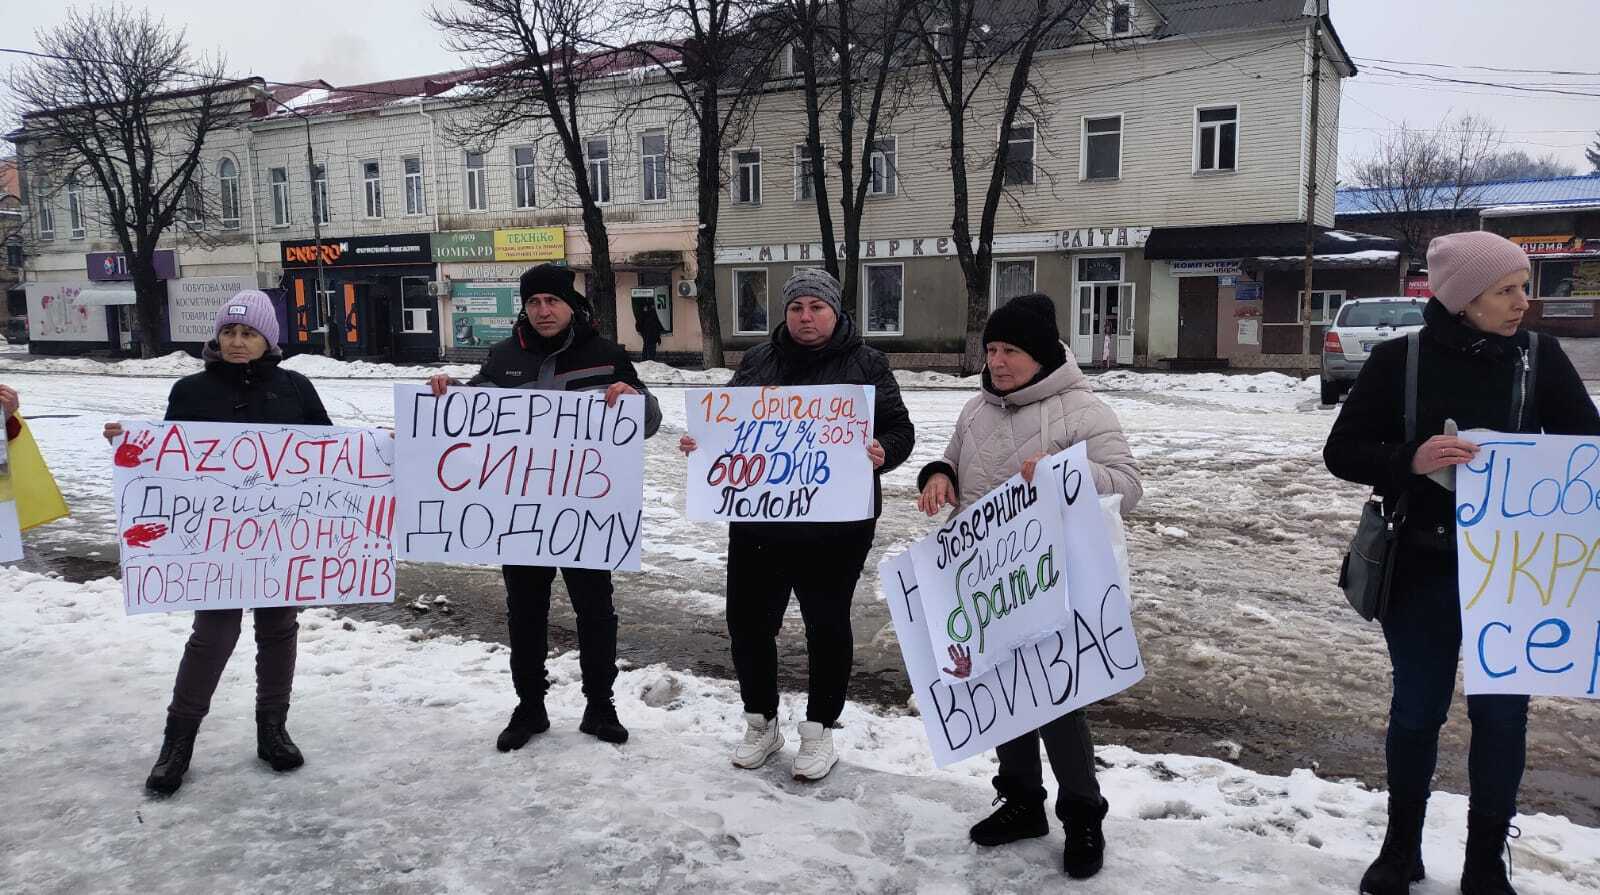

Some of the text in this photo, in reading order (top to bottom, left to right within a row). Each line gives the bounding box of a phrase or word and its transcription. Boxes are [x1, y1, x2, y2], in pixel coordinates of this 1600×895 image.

[1521, 242, 1564, 251] АУРМА
[182, 283, 219, 293] ПОБУТОВА
[178, 324, 214, 336] ГОСПОДА
[182, 311, 208, 321] ТОВАРИ
[700, 386, 856, 423] 12 бригада
[155, 424, 391, 481] AZOVSTAL
[725, 420, 792, 454] НГУ
[819, 418, 869, 445] 3057
[707, 453, 766, 486] 600
[1456, 441, 1600, 527] Пов
[295, 484, 342, 518] рік
[406, 500, 642, 571] ДОДОМУ
[968, 519, 1042, 587] мого
[125, 554, 392, 607] ПОВЕРНІТЬ ГЕРОЇВ
[947, 548, 1060, 654] брата
